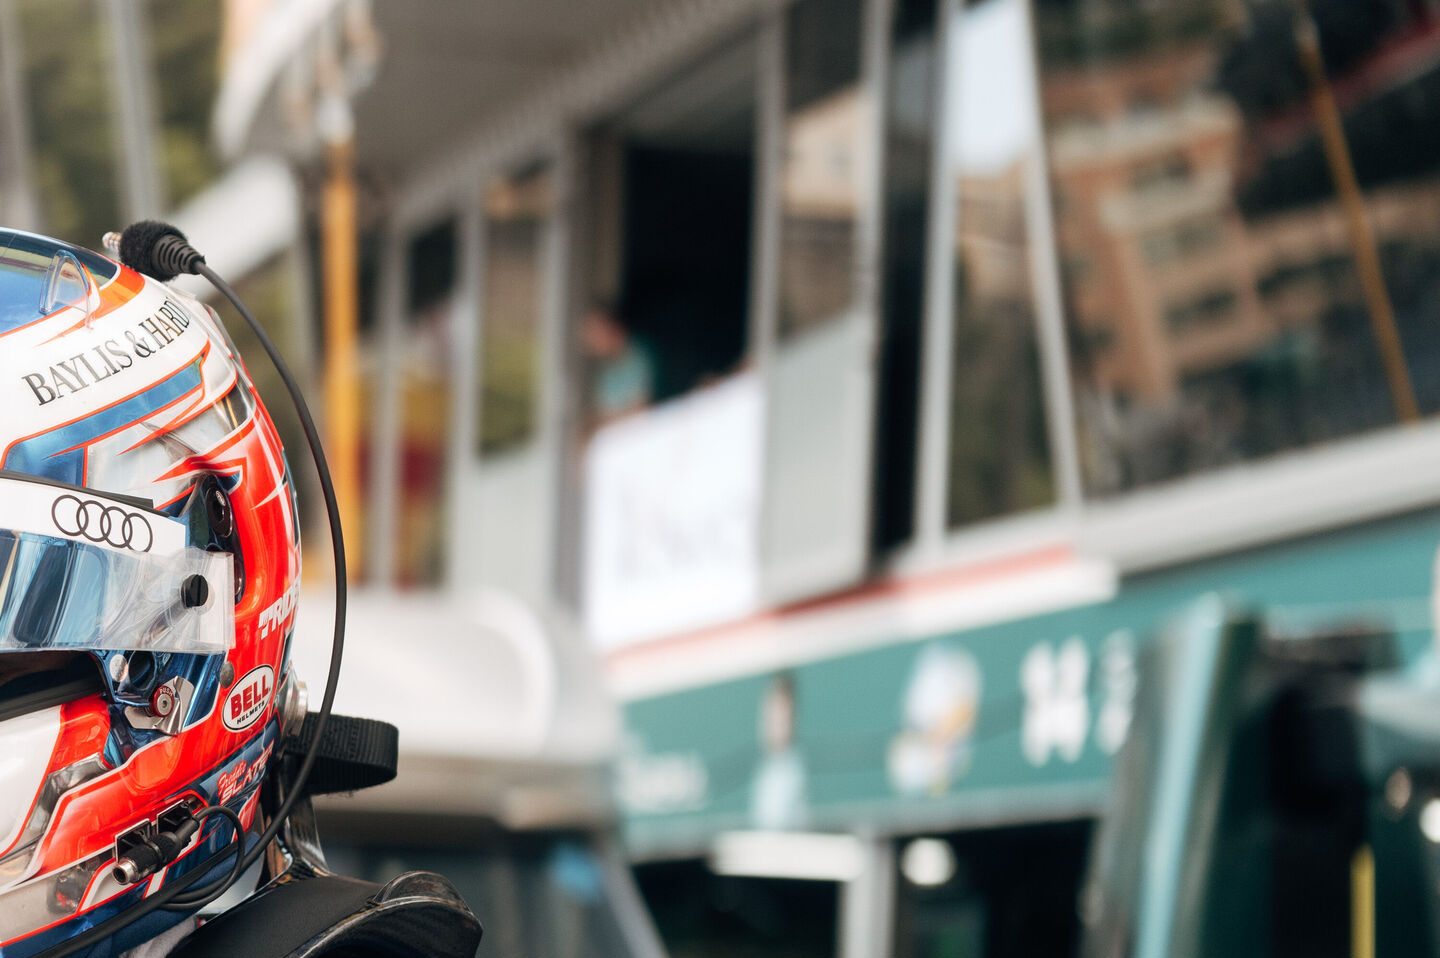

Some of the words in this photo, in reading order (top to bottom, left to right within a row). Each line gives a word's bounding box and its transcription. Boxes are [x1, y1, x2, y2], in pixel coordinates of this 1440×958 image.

[124, 330, 157, 358] &
[139, 298, 190, 349] HARD
[21, 339, 133, 406] BAYLIS
[230, 674, 270, 720] BELL
[236, 700, 265, 724] HELMETS
